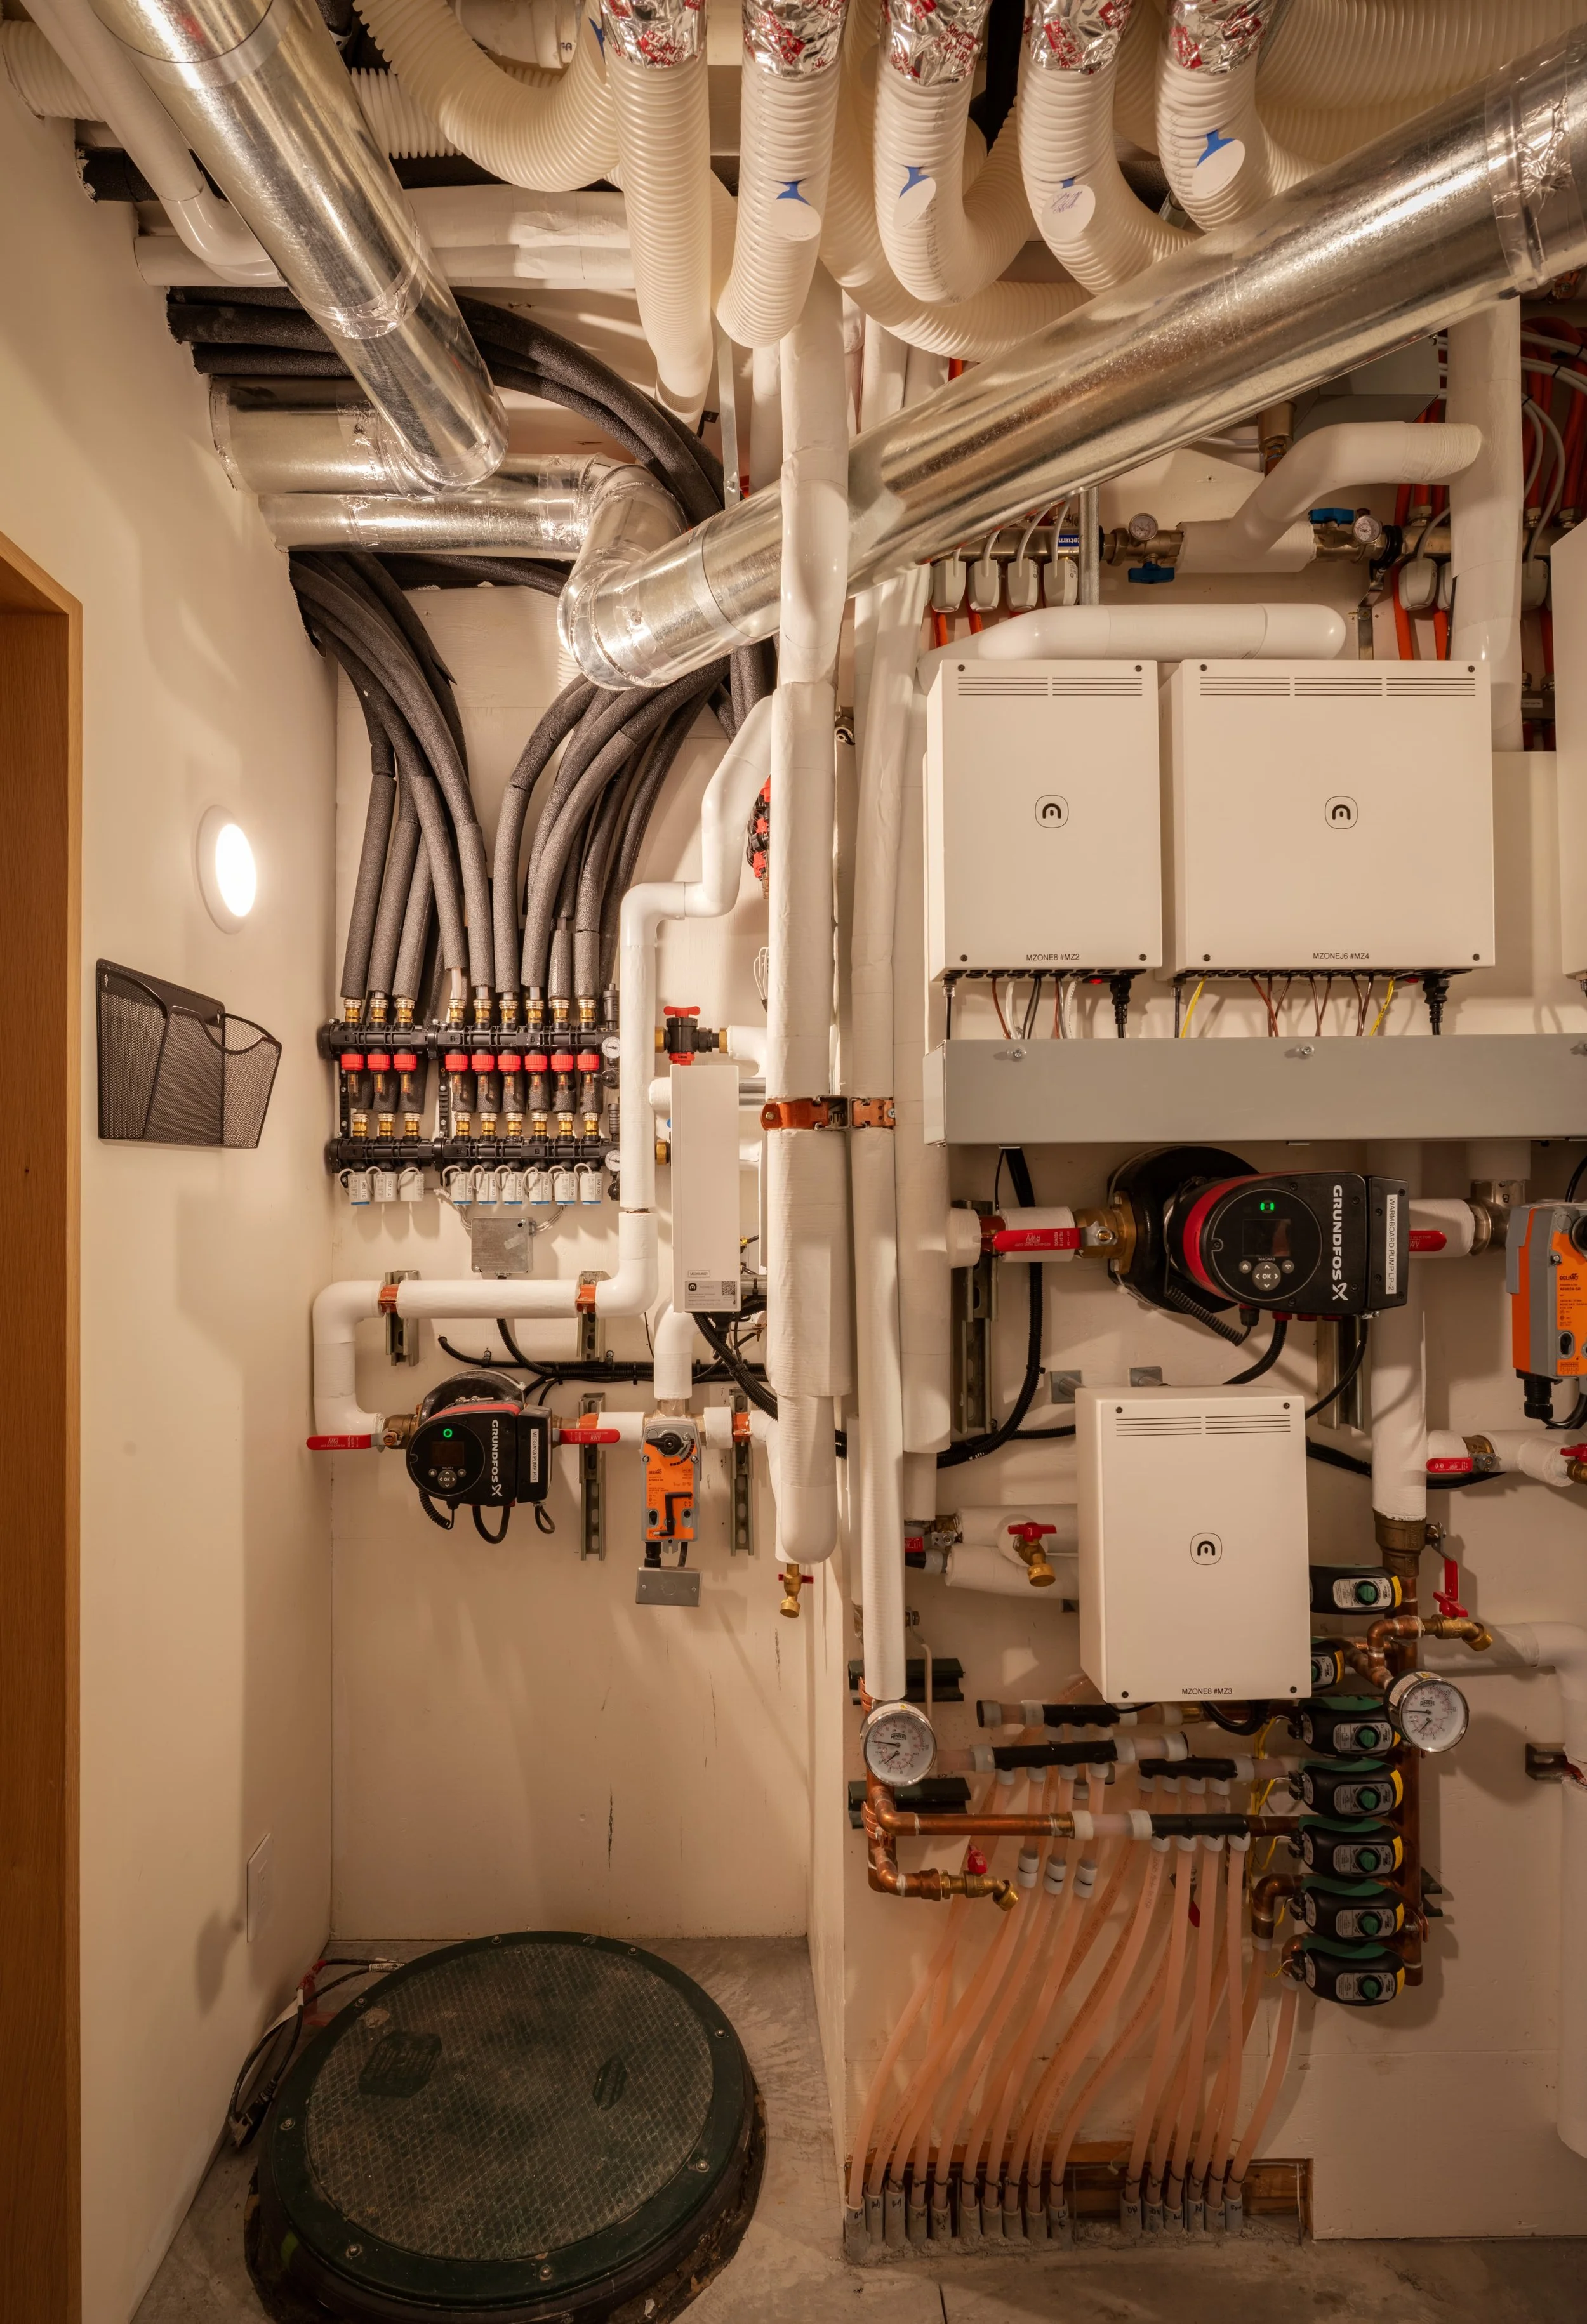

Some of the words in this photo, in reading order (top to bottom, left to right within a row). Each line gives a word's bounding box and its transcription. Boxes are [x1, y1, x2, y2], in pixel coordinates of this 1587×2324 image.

[1313, 952, 1348, 960] MZONEJ6
[1350, 952, 1370, 960] #MZ4
[1332, 1184, 1343, 1281] GRUNDFOS
